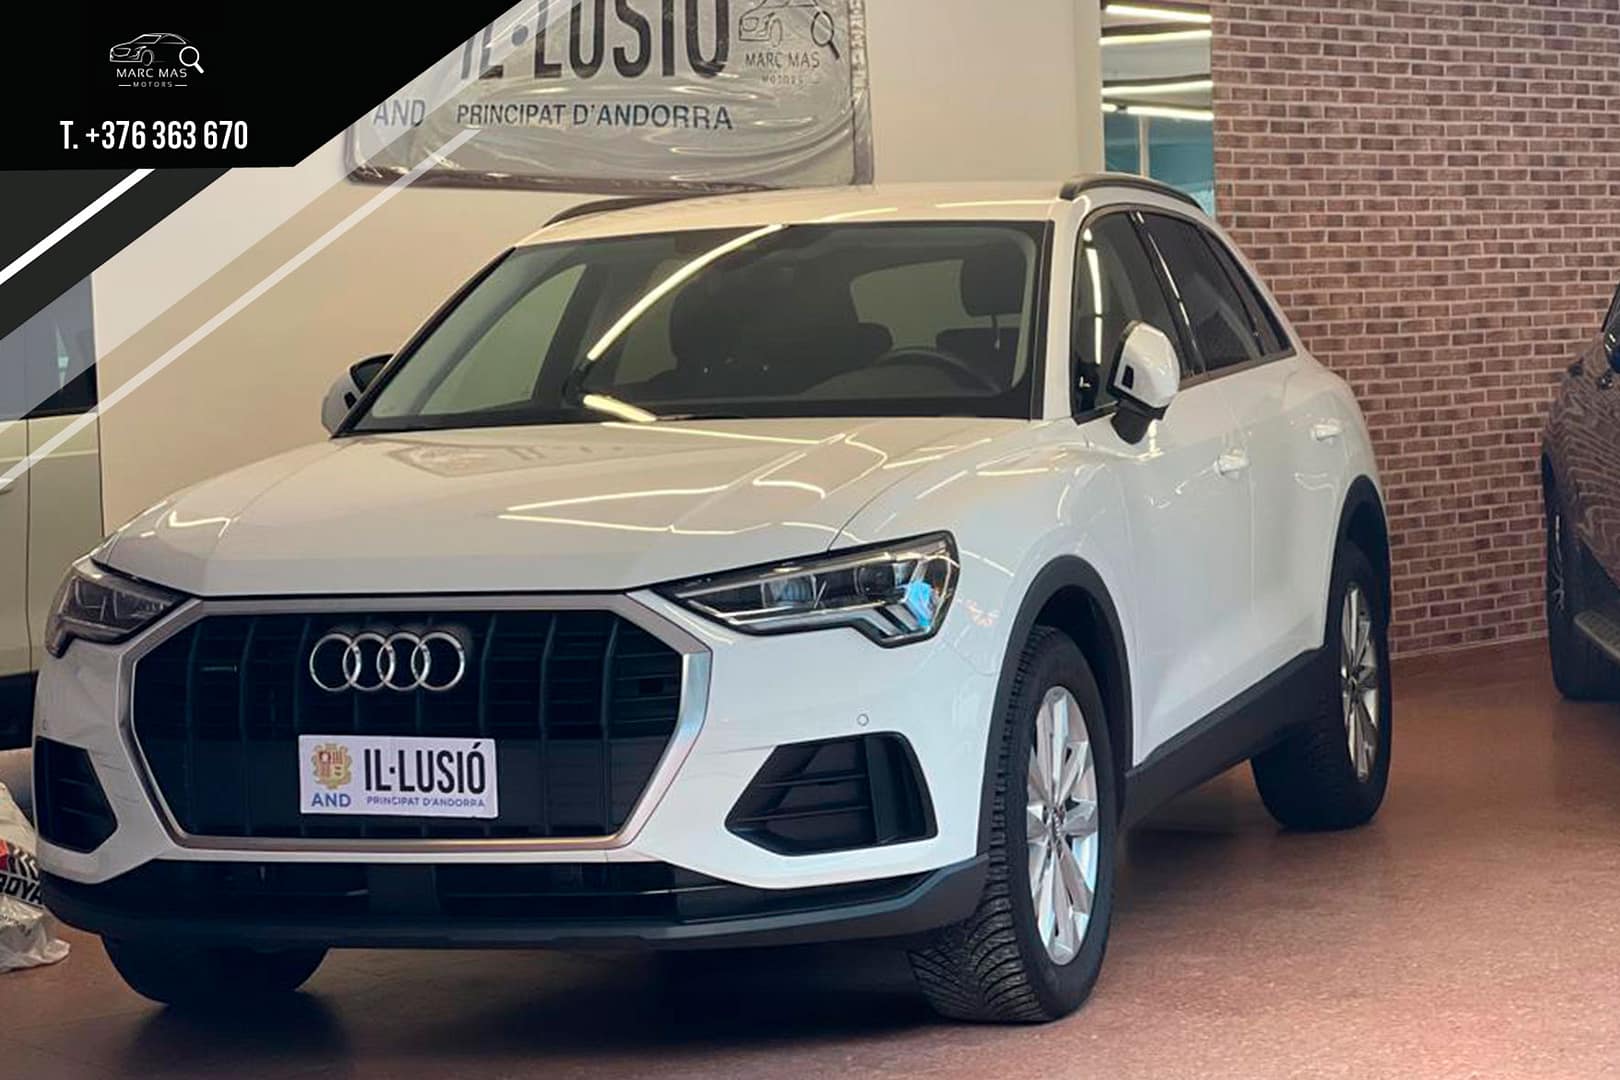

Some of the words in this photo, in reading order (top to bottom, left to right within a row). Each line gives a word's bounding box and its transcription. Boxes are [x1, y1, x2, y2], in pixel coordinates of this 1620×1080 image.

[745, 51, 783, 69] MARC
[788, 51, 821, 69] MAS
[373, 99, 426, 128] AND
[456, 103, 567, 126] PRINCIPAT
[573, 103, 734, 130] D'ANDORRA
[364, 741, 486, 794] IL·LUSIÓ
[310, 792, 353, 808] AND
[366, 795, 421, 807] PRINCIPAT
[422, 797, 486, 809] D'ANDORRA
